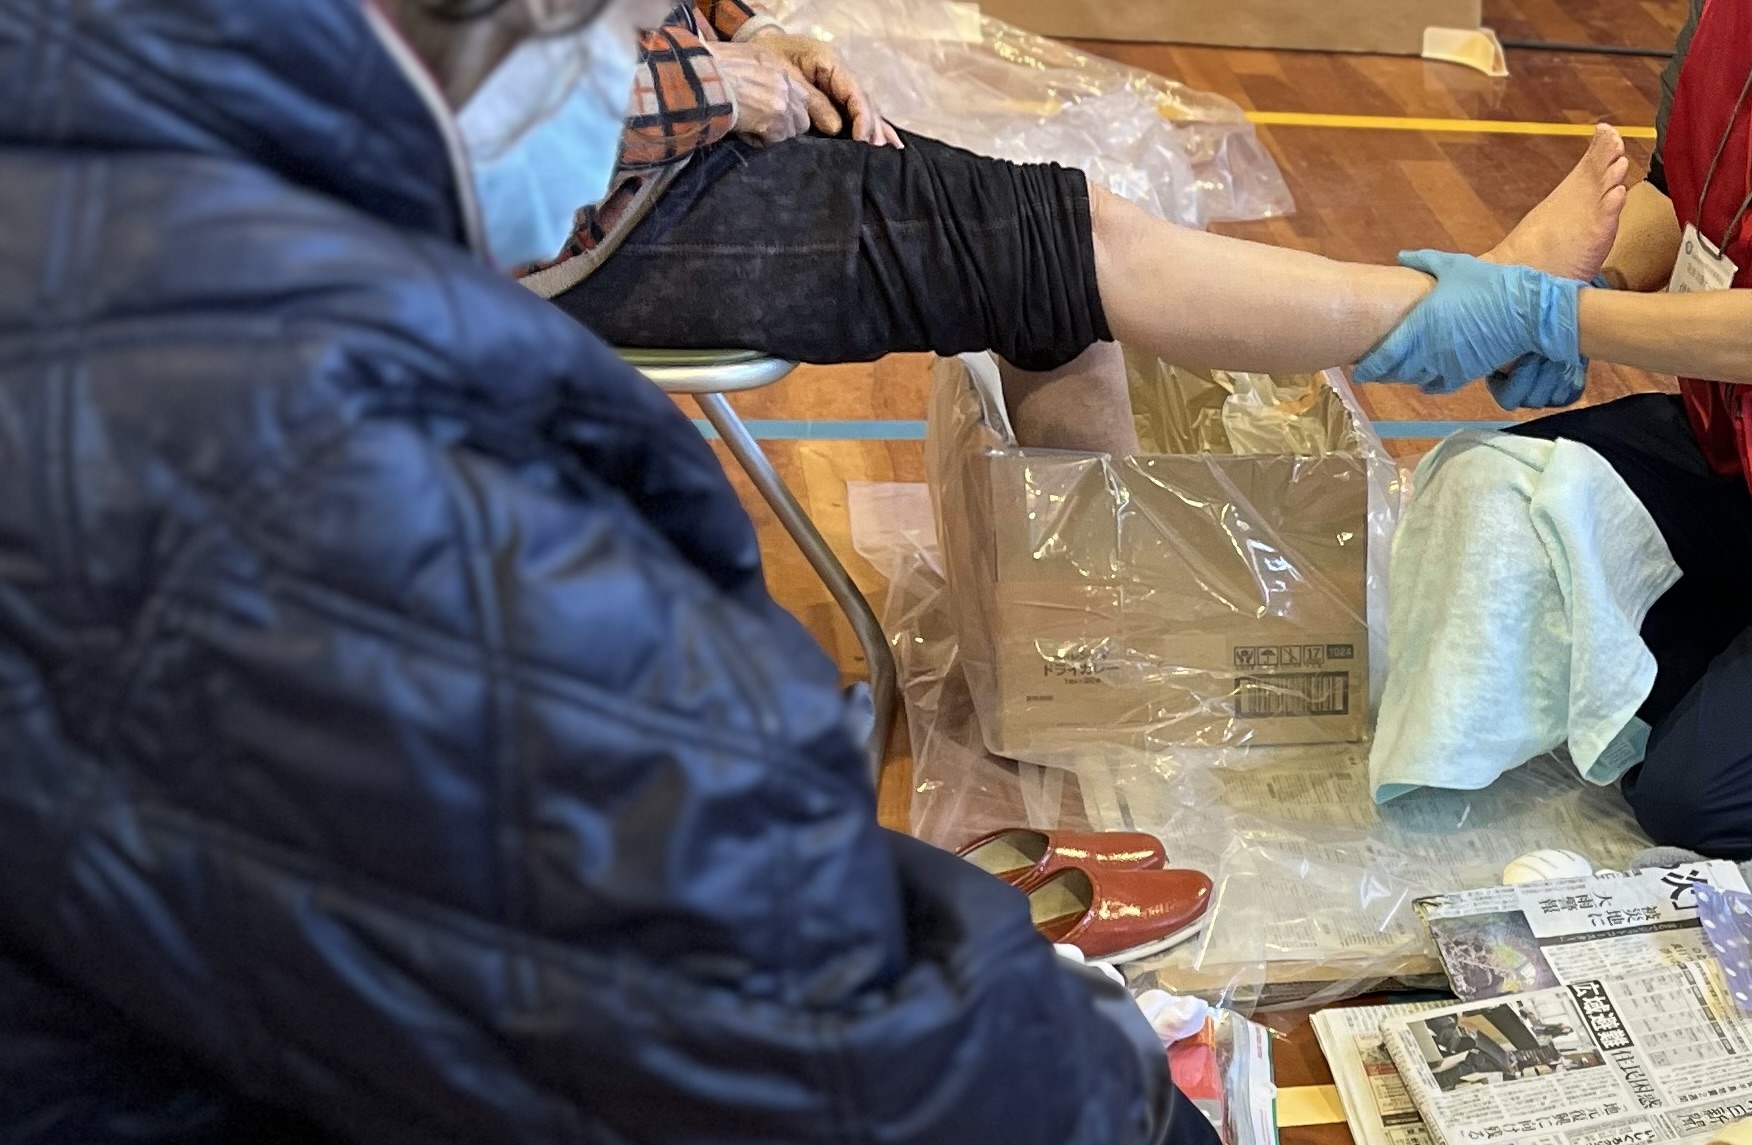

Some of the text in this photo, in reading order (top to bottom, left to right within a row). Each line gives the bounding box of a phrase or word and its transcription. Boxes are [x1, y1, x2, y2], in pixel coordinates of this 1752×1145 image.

[1538, 892, 1613, 914] 大雨警報
[1588, 906, 1662, 927] 被災地に
[1571, 982, 1631, 1049] 広域避難
[1610, 1050, 1663, 1109] 住民困惑
